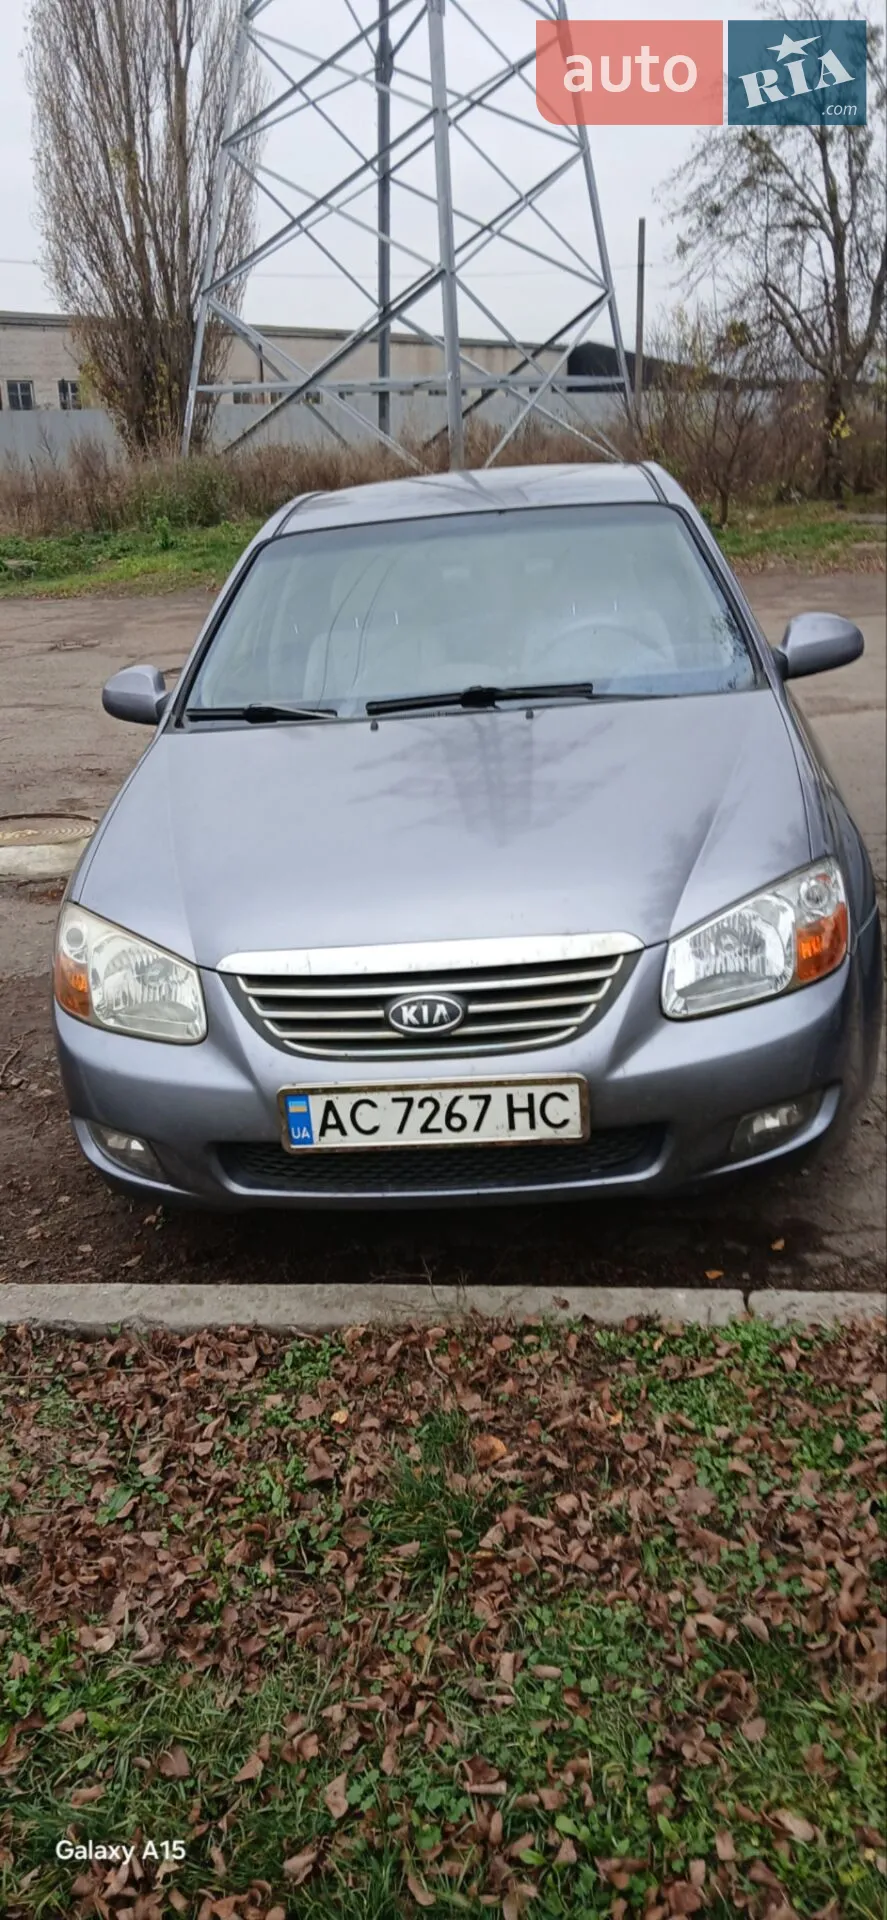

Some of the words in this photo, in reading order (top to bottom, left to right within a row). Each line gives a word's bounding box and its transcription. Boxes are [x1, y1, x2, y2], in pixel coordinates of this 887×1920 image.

[401, 1003, 450, 1025] KIA
[318, 1098, 380, 1138] AC
[391, 1094, 492, 1135] 7267
[506, 1092, 570, 1131] HC
[290, 1126, 311, 1140] UA
